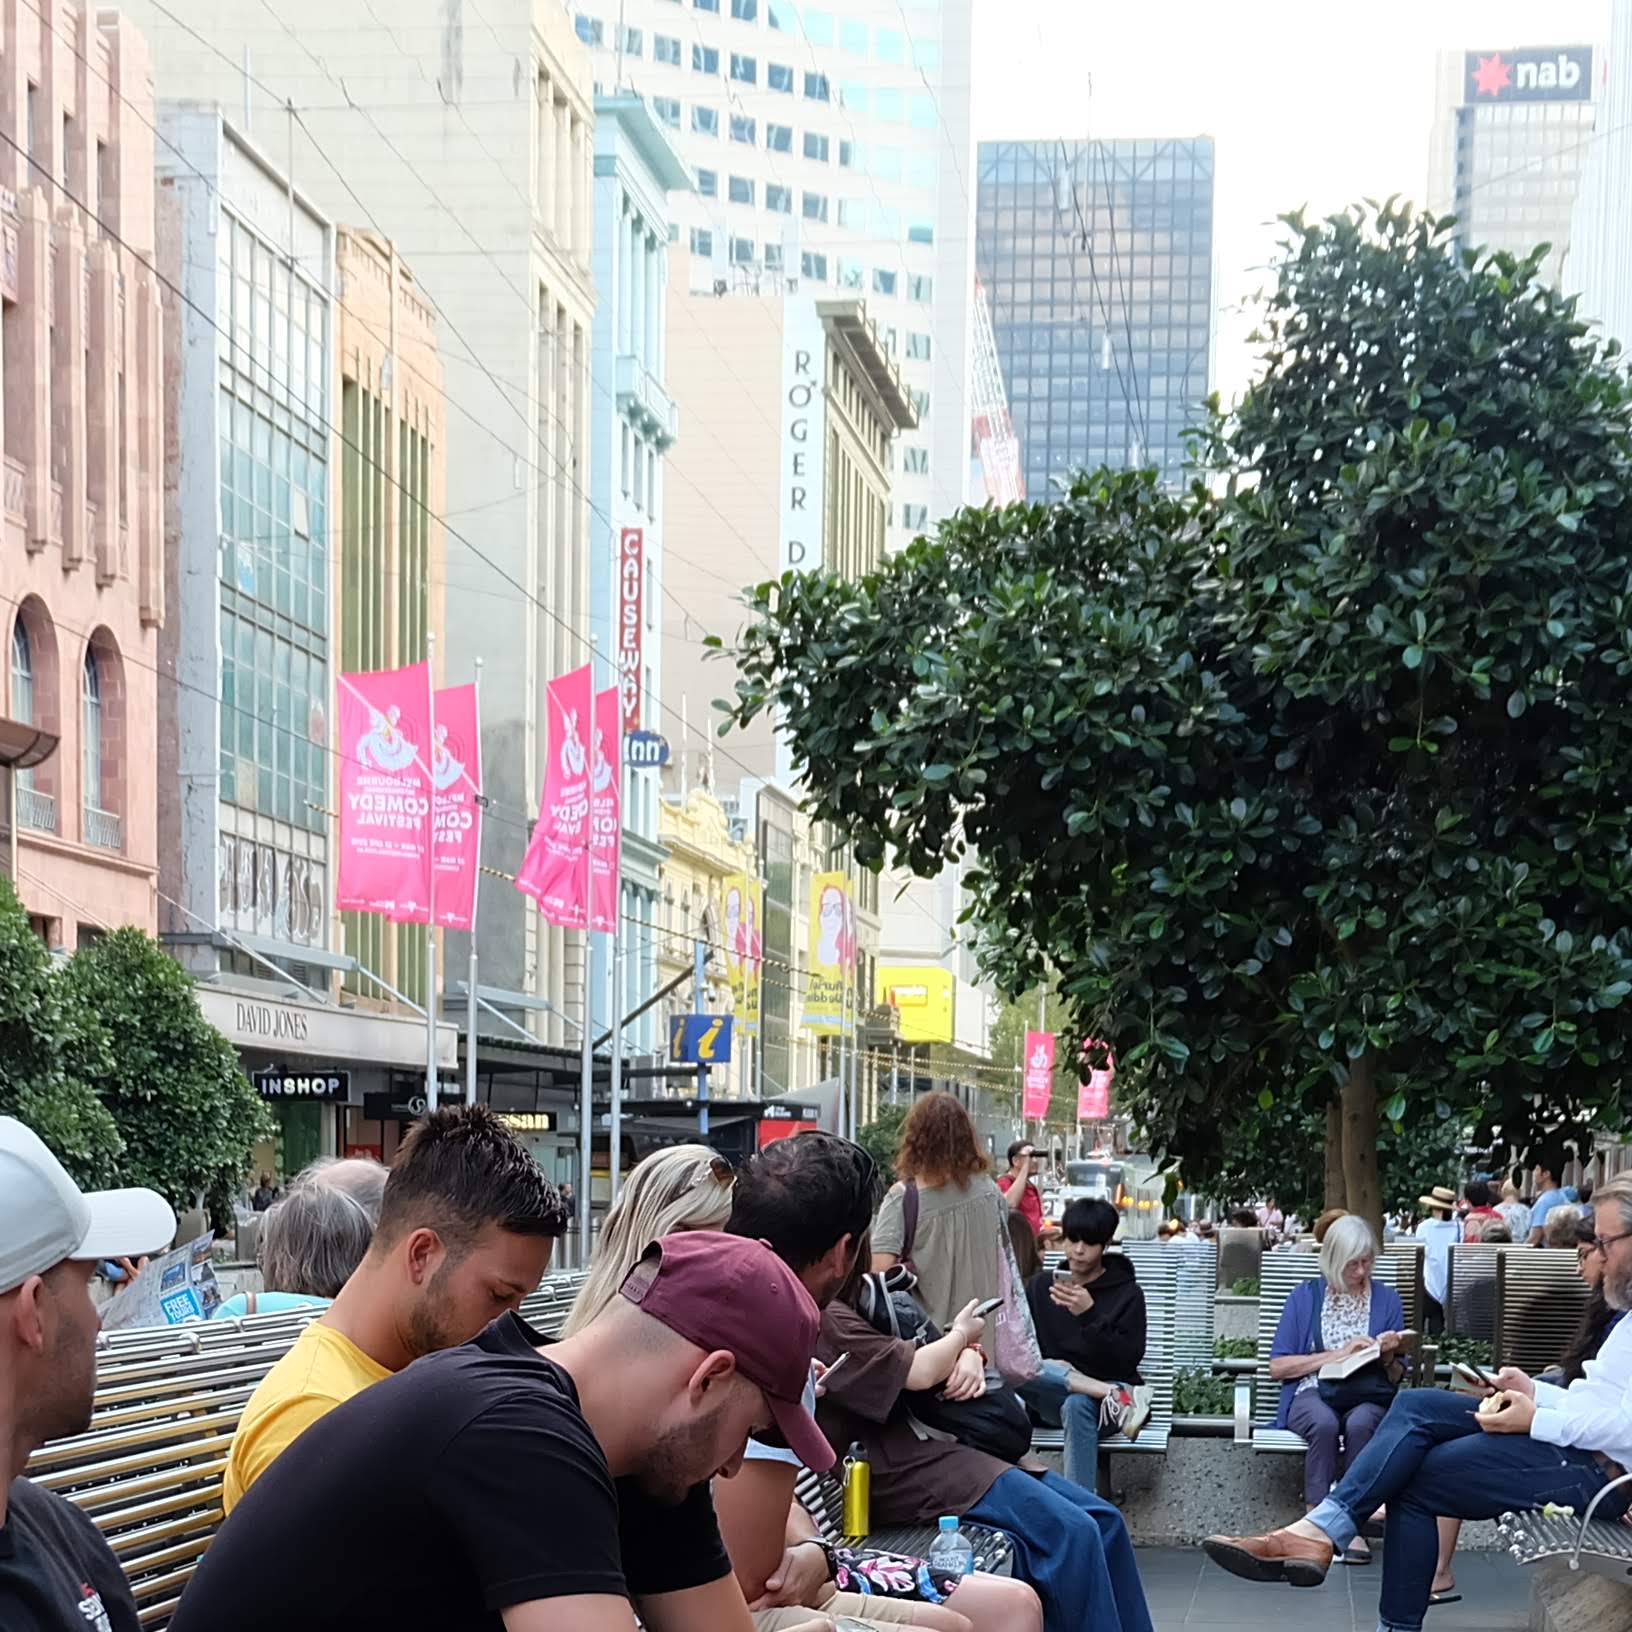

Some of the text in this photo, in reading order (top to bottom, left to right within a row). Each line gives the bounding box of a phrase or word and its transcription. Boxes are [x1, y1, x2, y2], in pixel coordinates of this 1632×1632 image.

[1515, 46, 1581, 88] nab
[789, 350, 816, 512] ROGER
[619, 533, 640, 718] CAUSEWAY
[624, 735, 661, 762] Inn
[236, 1003, 308, 1041] DAVID JONES
[261, 1077, 340, 1095] INSHOP
